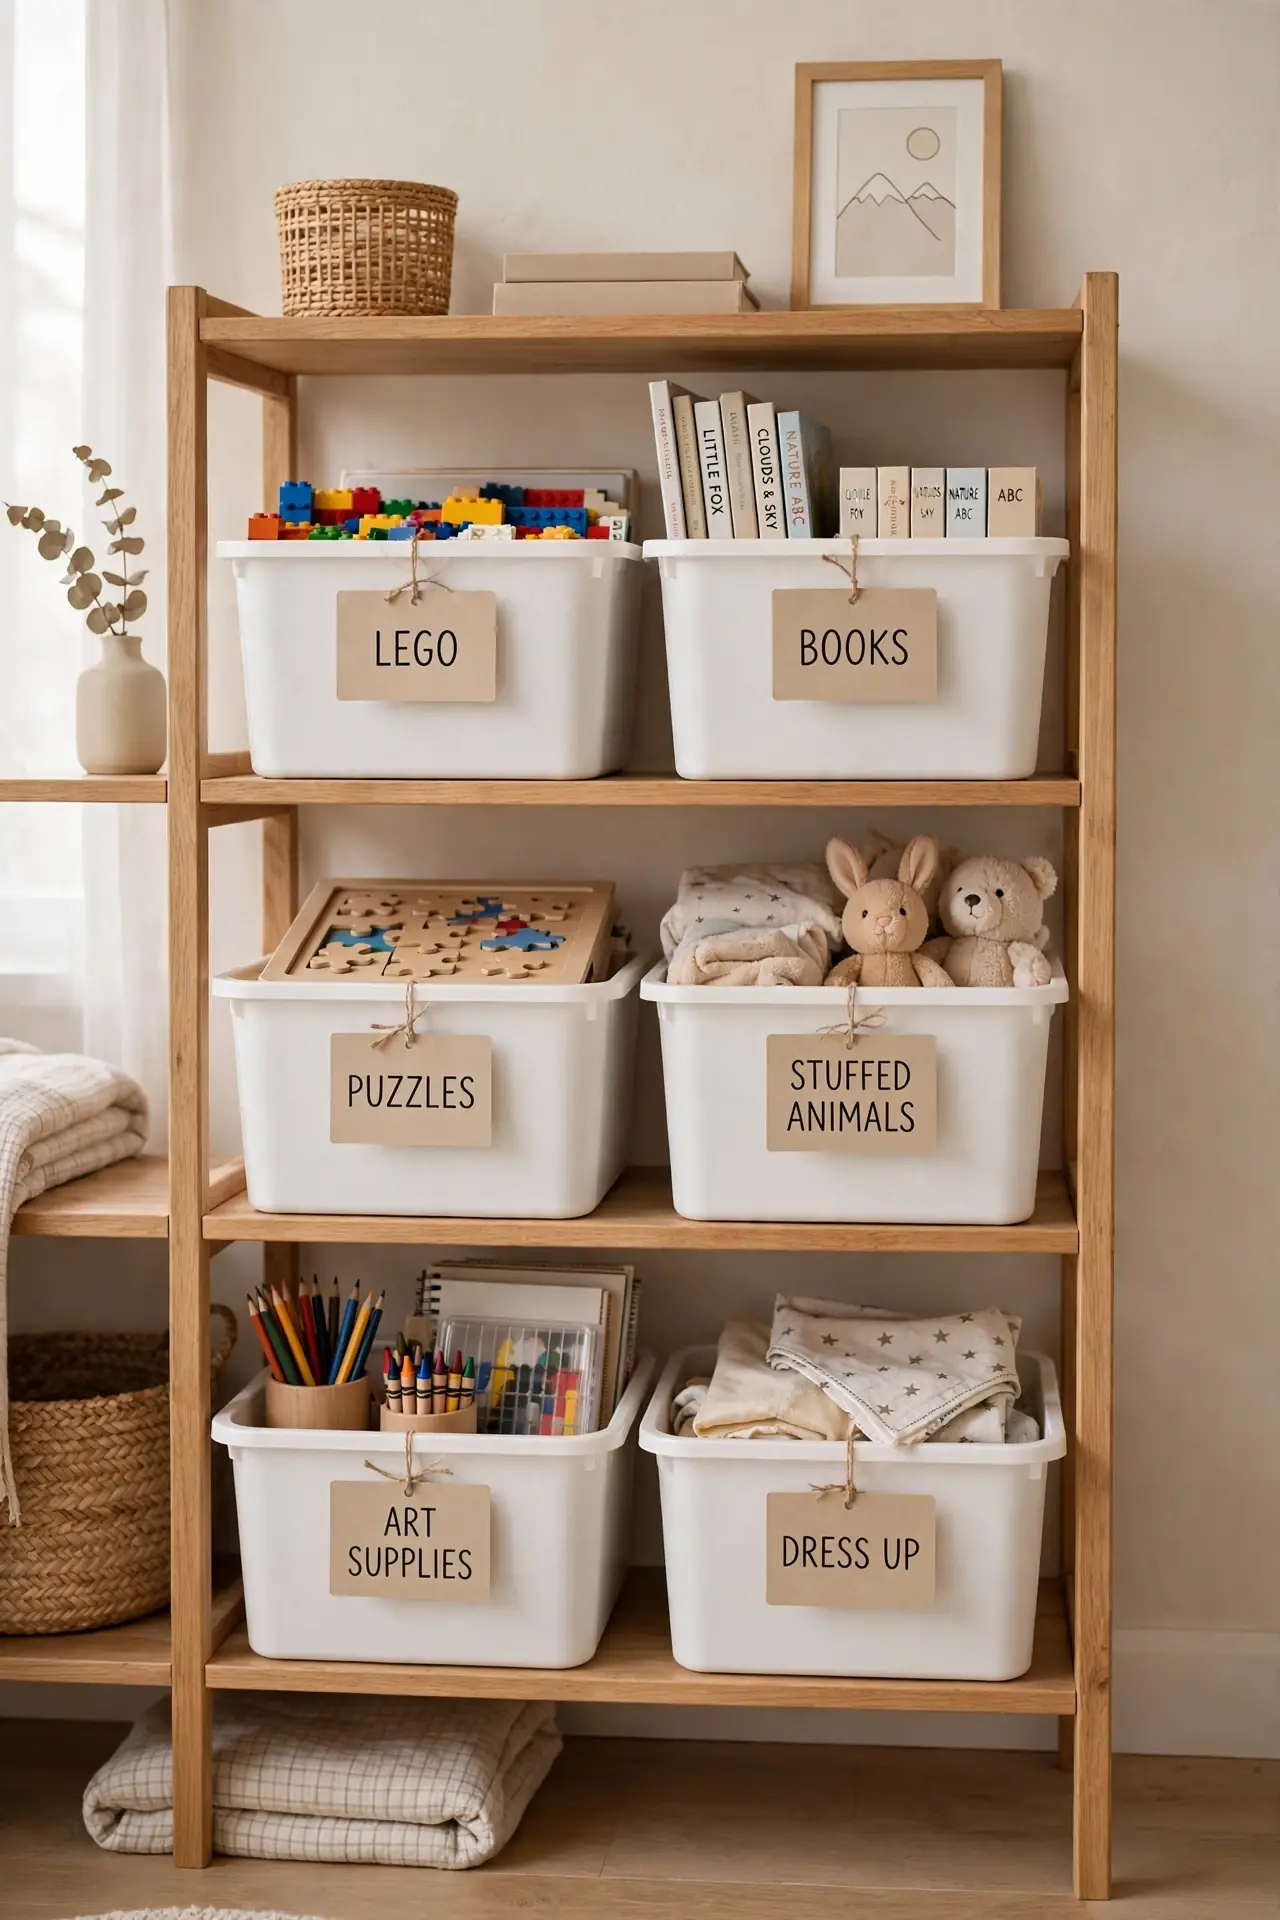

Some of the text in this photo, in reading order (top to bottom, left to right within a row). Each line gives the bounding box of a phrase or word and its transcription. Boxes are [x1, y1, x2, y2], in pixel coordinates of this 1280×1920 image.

[702, 429, 725, 515] LITTLE FOX
[757, 428, 778, 530] CLOUDS & SKY
[786, 430, 805, 526] NATURE ABC
[949, 486, 979, 501] NATURE
[997, 488, 1023, 502] ABC
[954, 507, 973, 520] ABC
[376, 629, 458, 667] LEGO
[800, 628, 909, 667] BOOKS
[348, 1074, 475, 1110] PUZZLES
[790, 1059, 911, 1091] STUFFED
[786, 1100, 915, 1133] ANIMALS
[383, 1506, 437, 1538] ART
[348, 1545, 473, 1581] SUPPLIES
[782, 1535, 920, 1571] DRESS UP
